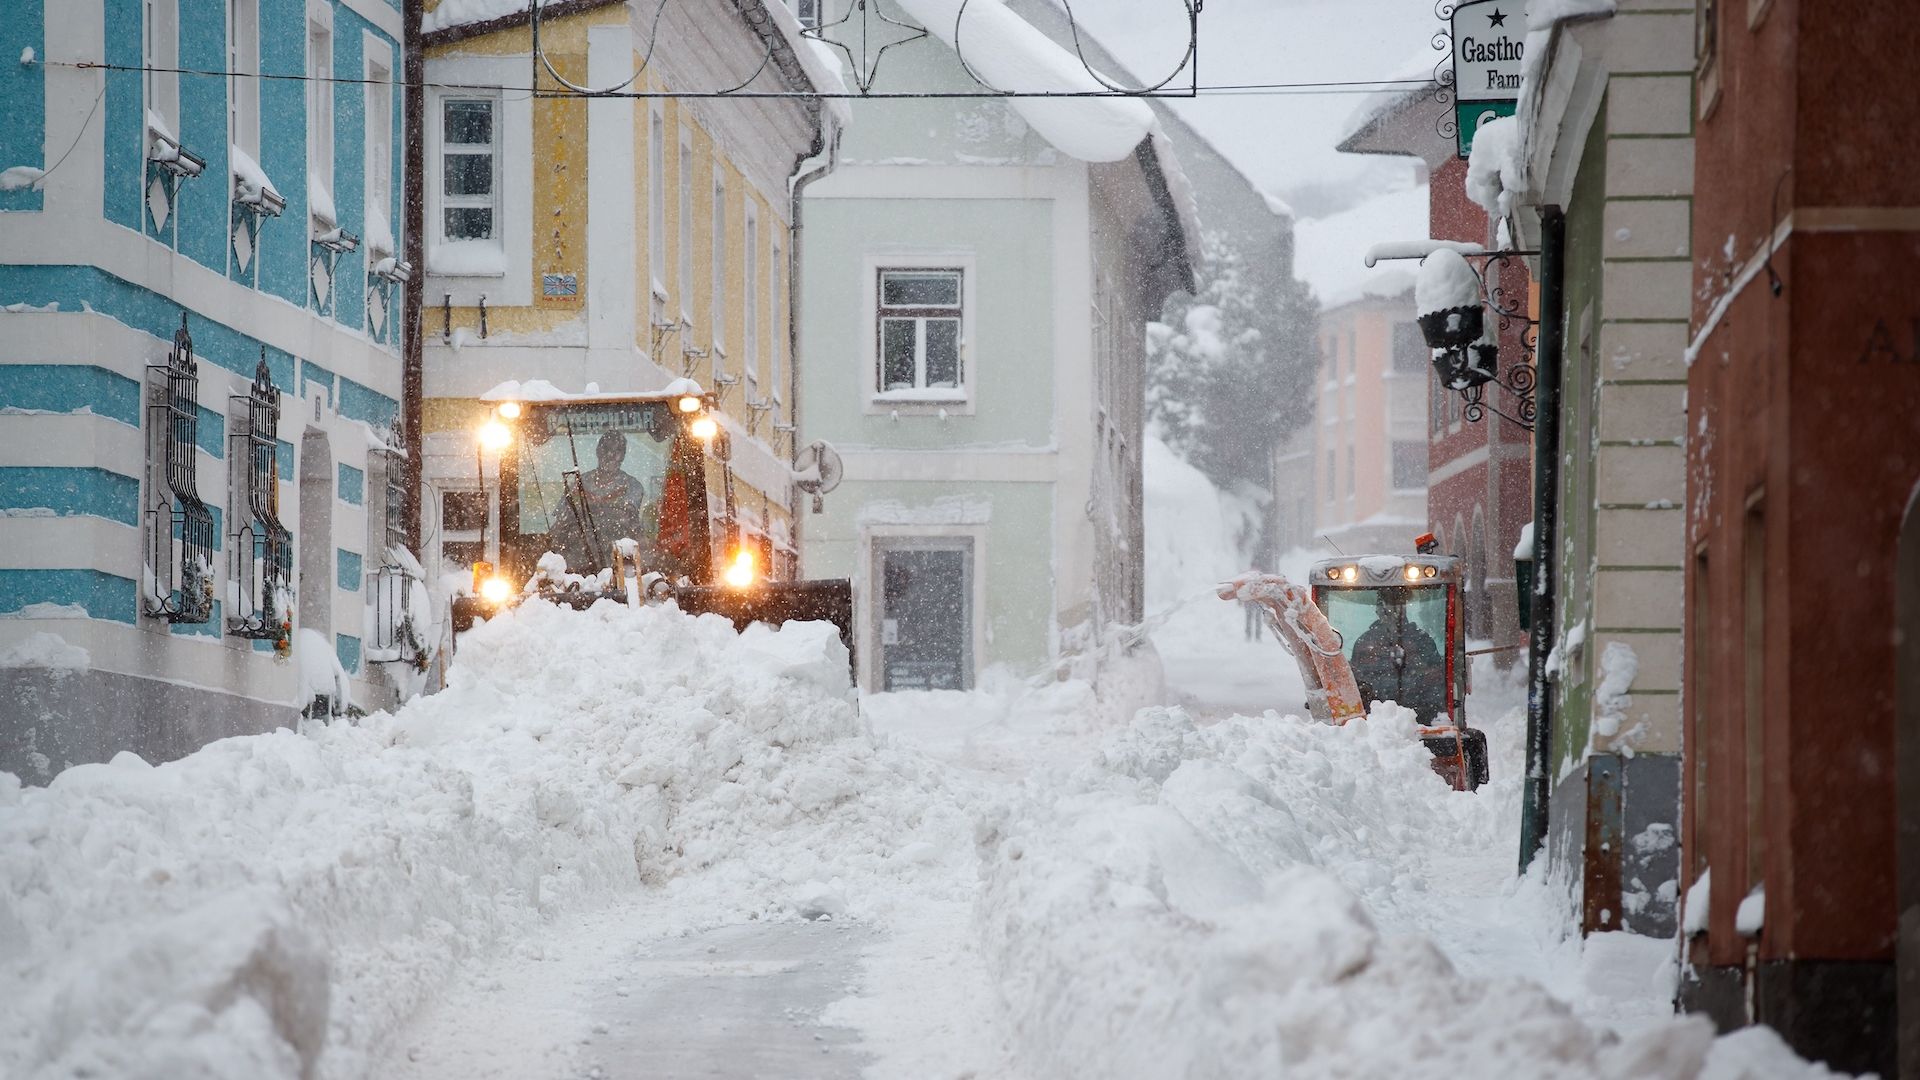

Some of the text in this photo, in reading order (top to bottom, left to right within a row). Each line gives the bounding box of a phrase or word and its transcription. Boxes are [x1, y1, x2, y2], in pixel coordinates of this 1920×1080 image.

[1462, 36, 1524, 63] Gastho
[1486, 70, 1524, 90] Fam
[547, 411, 655, 432] CATERPILLAR
